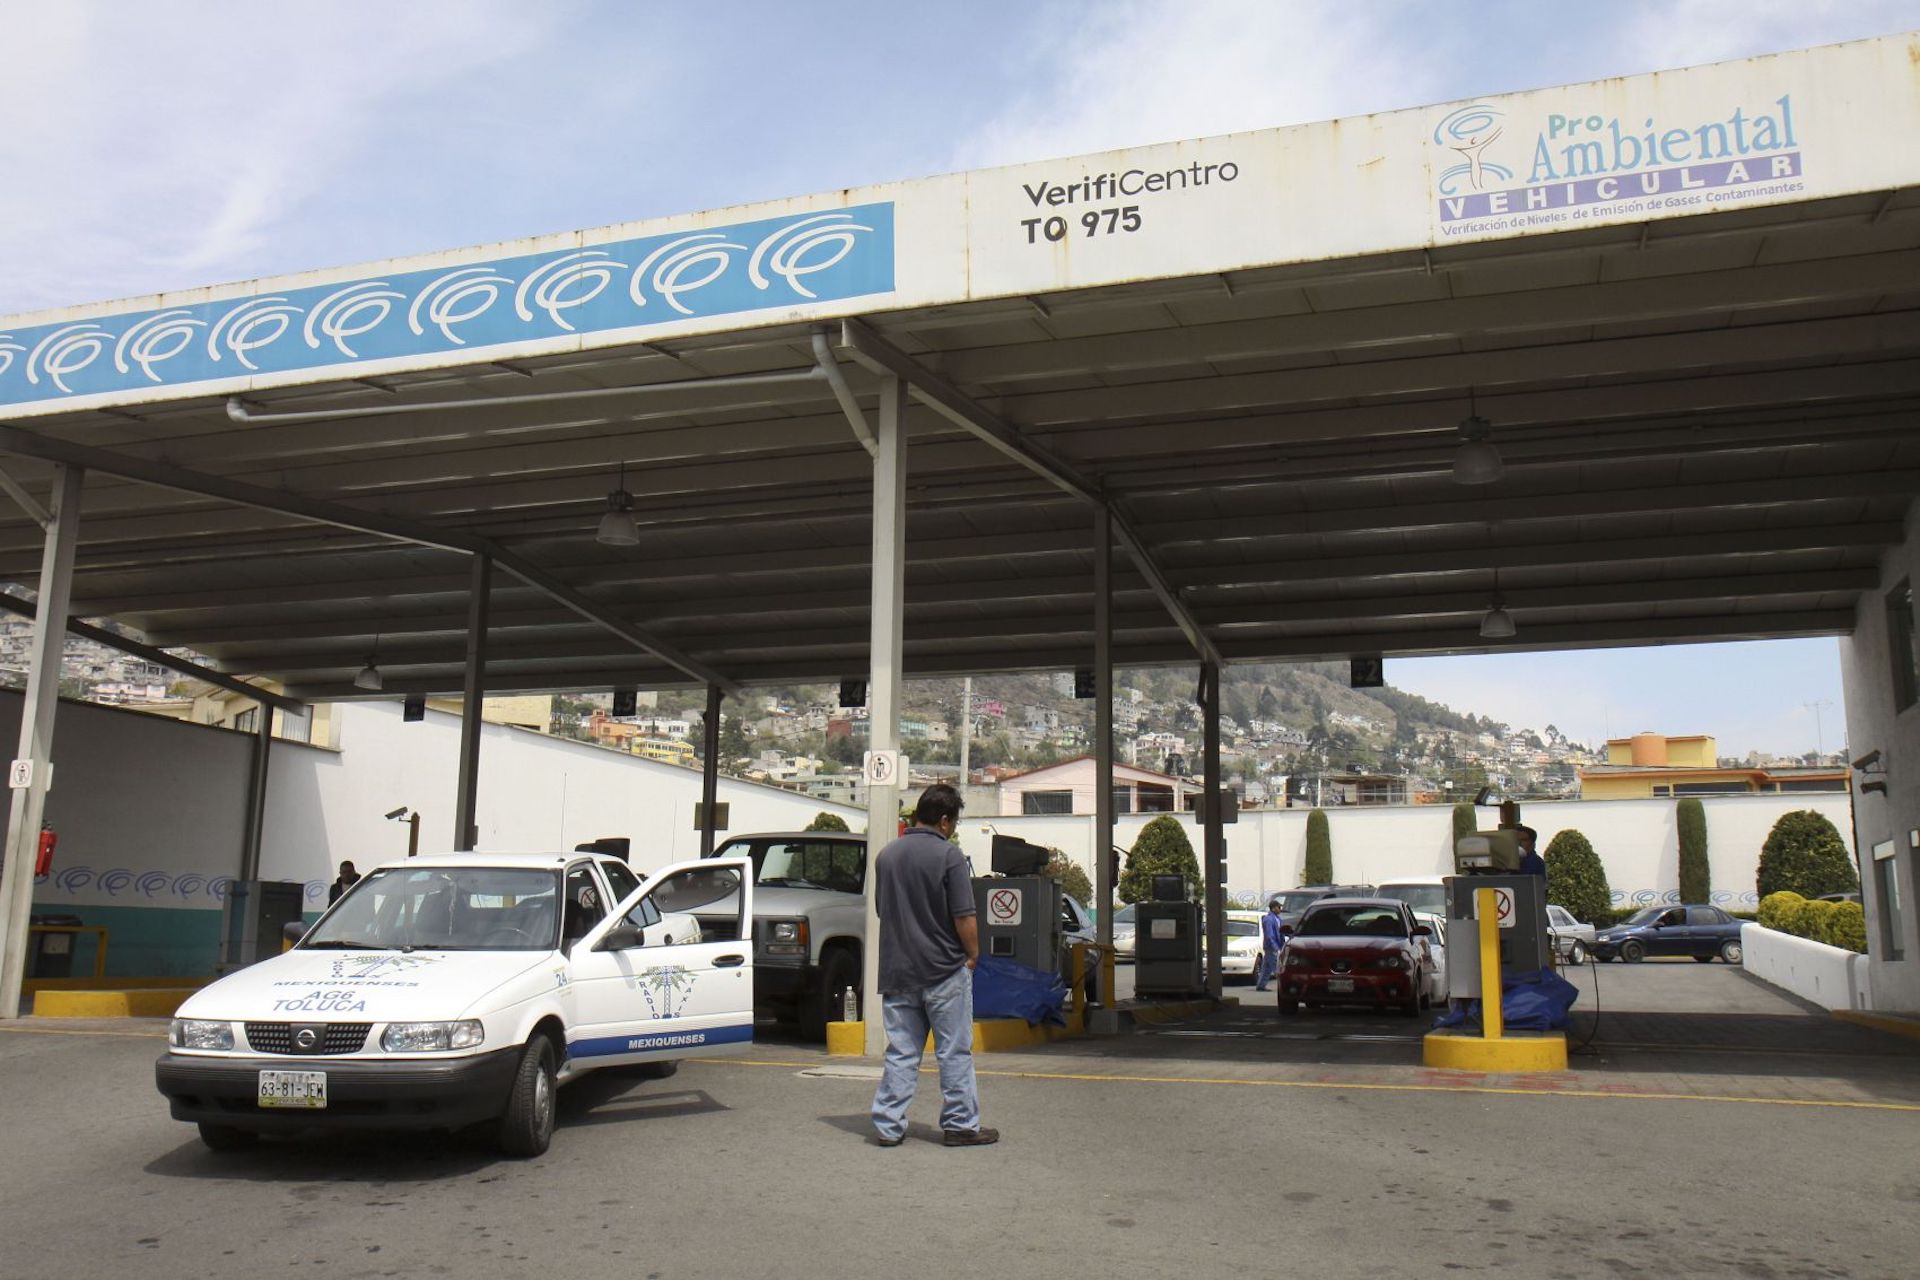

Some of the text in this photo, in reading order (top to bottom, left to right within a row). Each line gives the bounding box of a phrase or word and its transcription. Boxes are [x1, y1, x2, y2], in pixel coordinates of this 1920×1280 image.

[1526, 94, 1798, 183] Ambiental
[1548, 114, 1604, 139] Pro
[1022, 161, 1239, 207] VerifiCentro
[1445, 156, 1793, 219] VEHICULAR
[1021, 205, 1142, 244] TO 975
[1442, 181, 1804, 236] Verificación de Niveles de Emisión de Gases Contaminantes
[272, 1000, 367, 1012] TOLUCA
[628, 1033, 706, 1050] MEXIQUENSES
